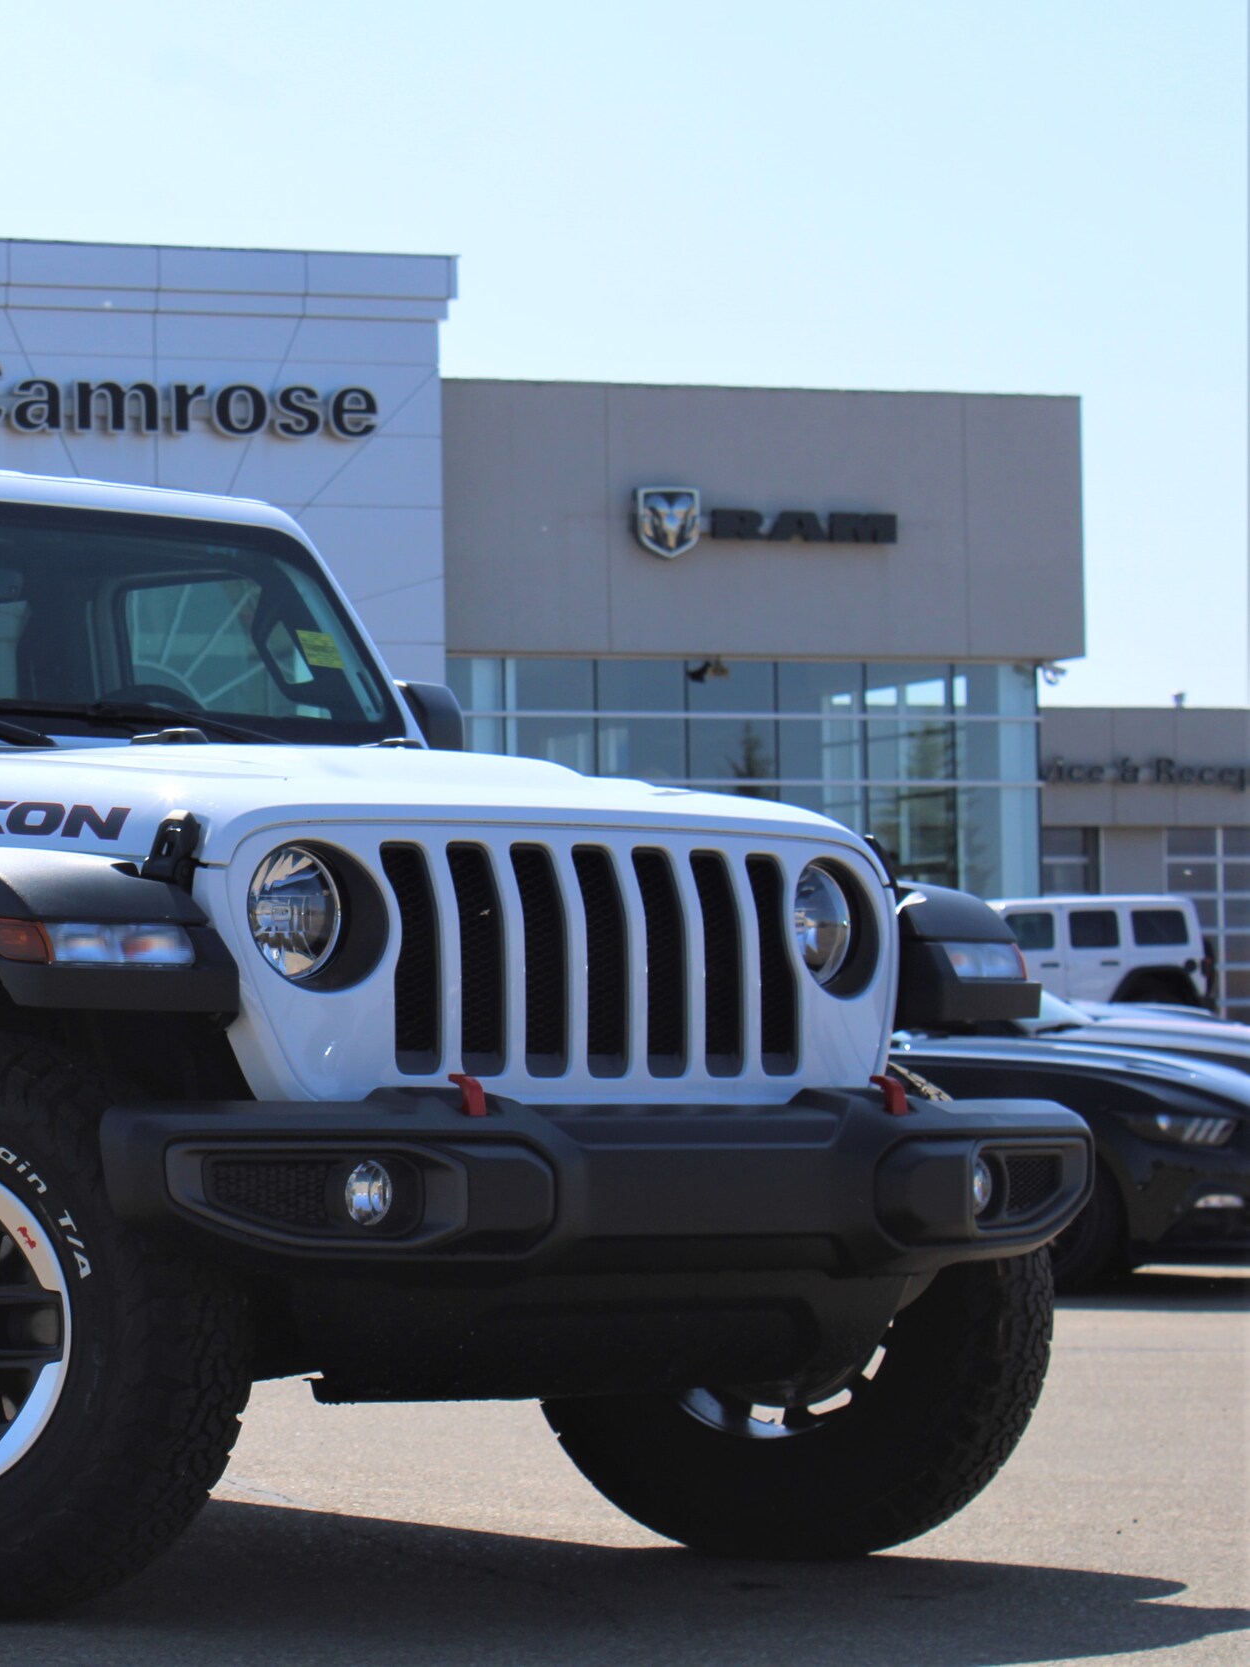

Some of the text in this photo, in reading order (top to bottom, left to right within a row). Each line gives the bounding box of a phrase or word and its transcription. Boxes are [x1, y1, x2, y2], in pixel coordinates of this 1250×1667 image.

[710, 508, 898, 544] RAM
[1120, 757, 1141, 784] &
[57, 1209, 93, 1280] T/A
